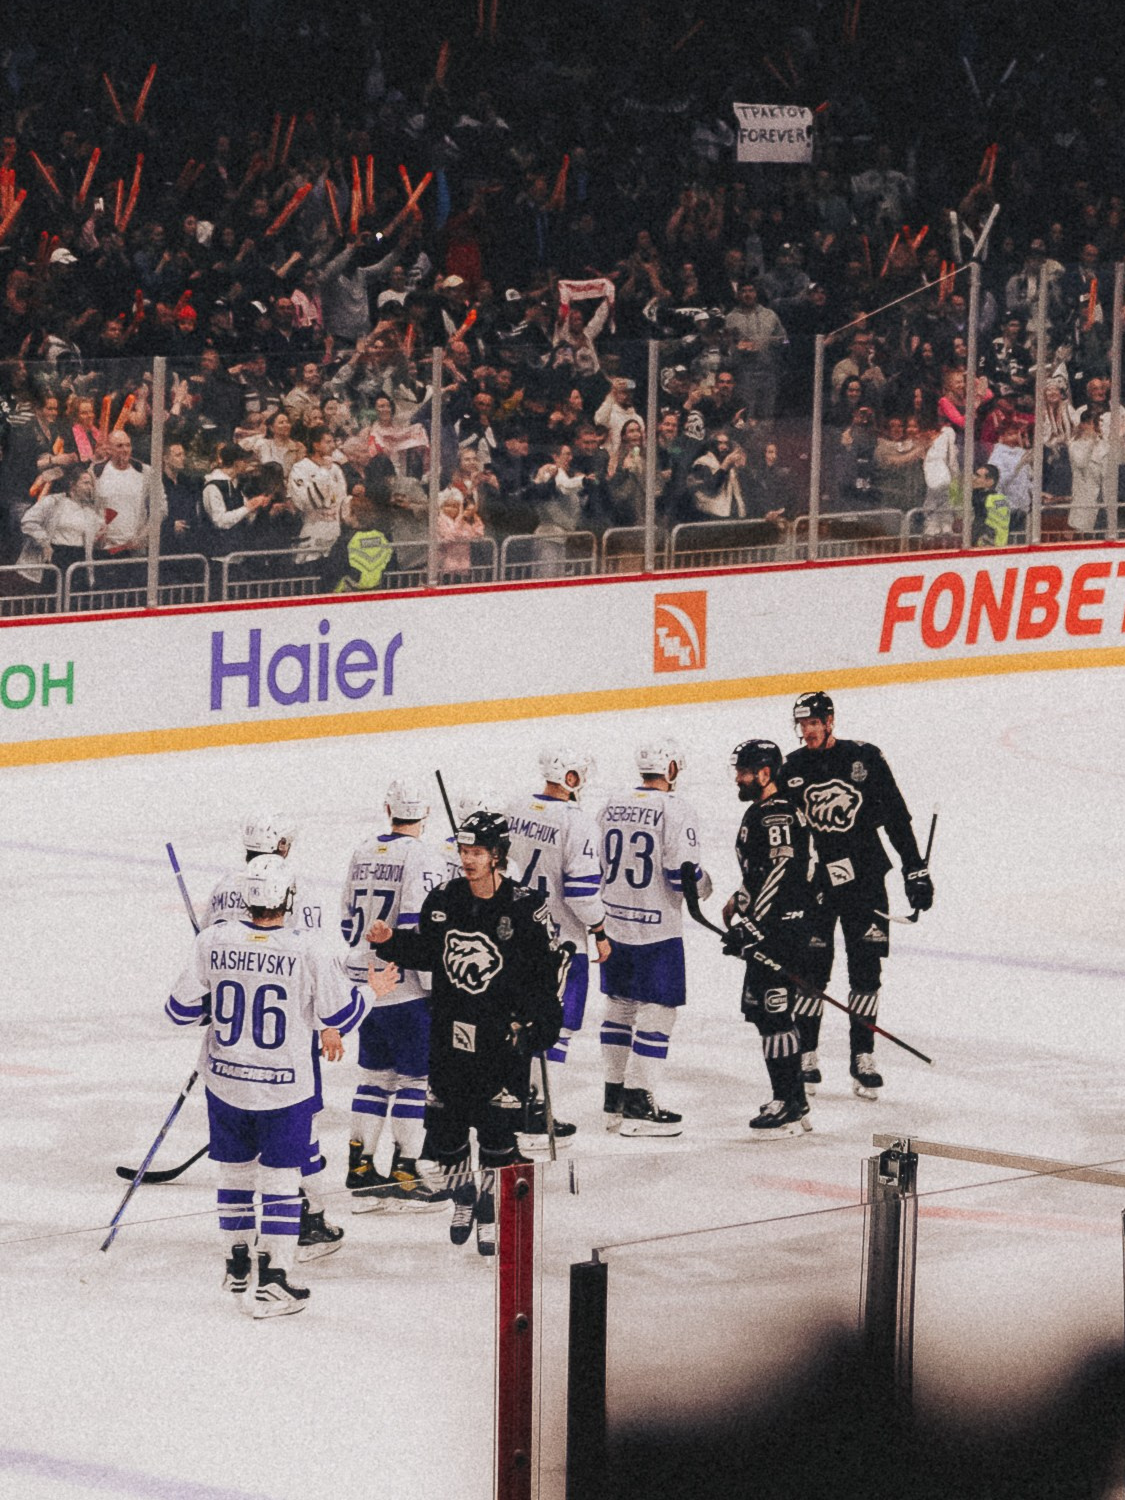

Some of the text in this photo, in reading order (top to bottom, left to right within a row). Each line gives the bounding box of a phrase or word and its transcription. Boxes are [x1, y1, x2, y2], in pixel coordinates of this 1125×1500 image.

[739, 125, 813, 148] FOREVER!
[210, 618, 403, 711] Haier
[606, 806, 663, 827] SERGEYEV
[769, 825, 791, 846] 81
[605, 828, 655, 890] 93
[302, 906, 322, 928] 87
[210, 950, 297, 977] RASHEVSKY
[215, 979, 288, 1050] 96
